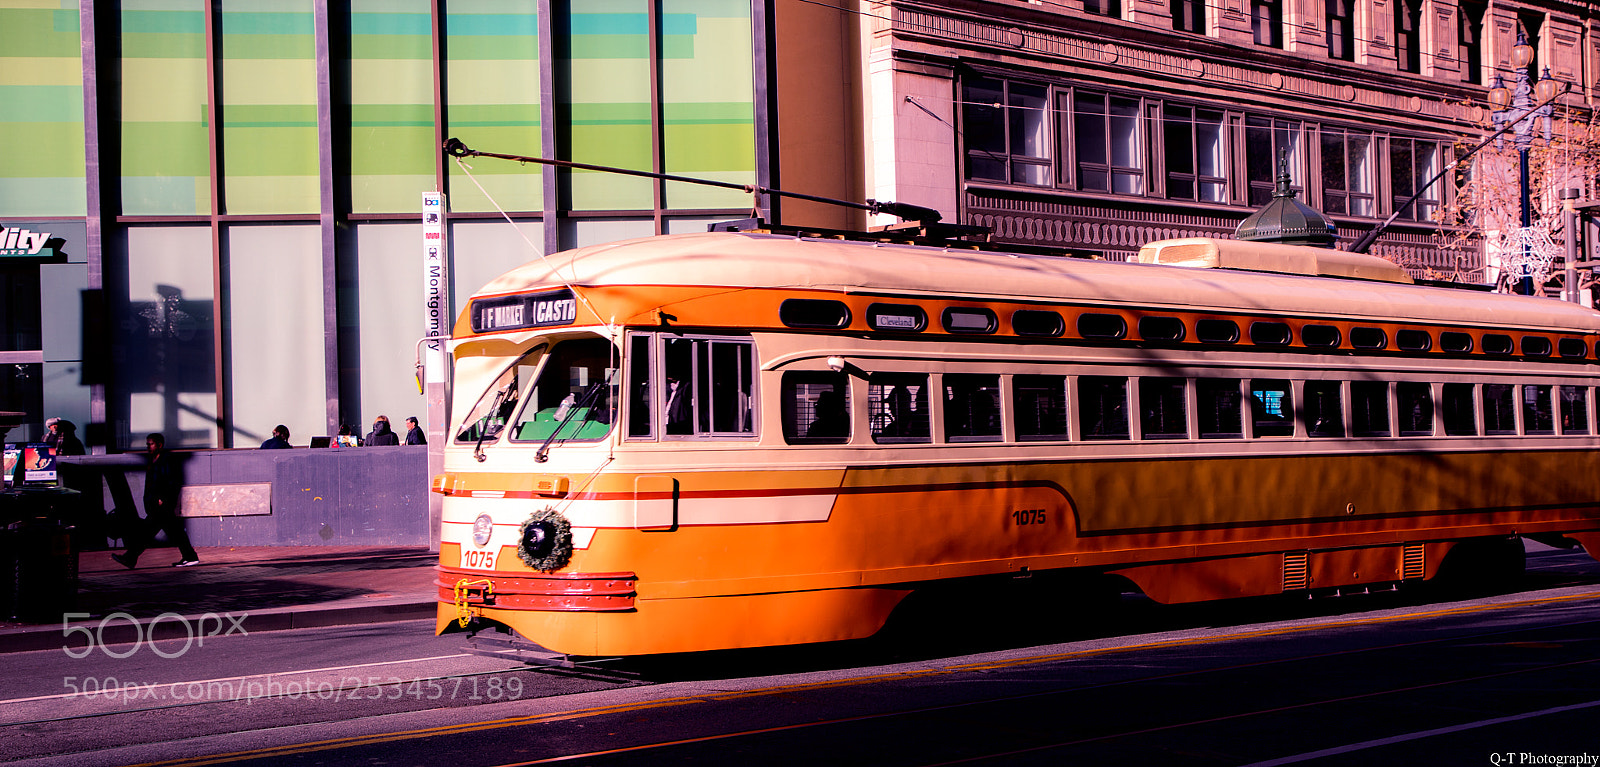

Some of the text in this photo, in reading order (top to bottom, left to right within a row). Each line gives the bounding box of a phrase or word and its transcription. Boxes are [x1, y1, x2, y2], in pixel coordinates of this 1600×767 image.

[427, 265, 441, 351] Montgomery
[880, 316, 913, 326] Cleveland
[1012, 509, 1046, 526] 1075
[464, 550, 494, 568] 1075
